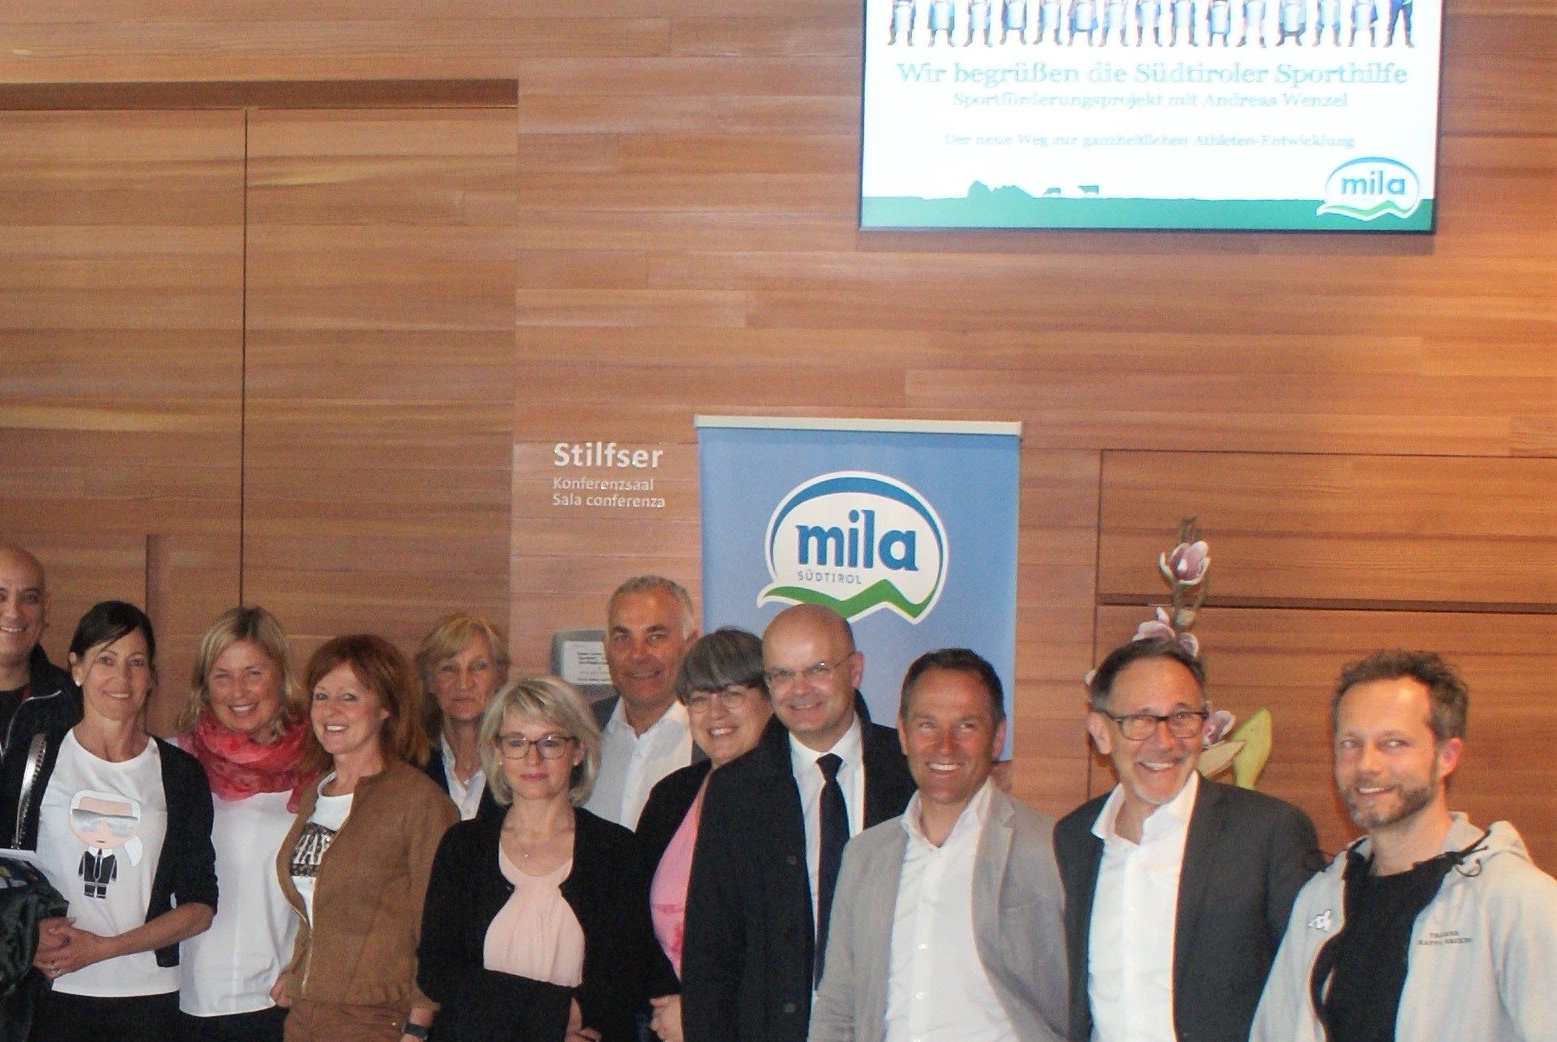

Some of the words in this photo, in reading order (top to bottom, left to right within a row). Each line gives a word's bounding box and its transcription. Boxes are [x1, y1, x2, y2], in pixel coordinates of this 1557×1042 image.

[897, 62, 947, 83] Wir
[954, 61, 1079, 88] begrüßen
[1087, 62, 1128, 83] die
[1134, 62, 1269, 84] Südtiroler
[1275, 62, 1408, 88] Sporthilfe
[953, 91, 1162, 109] Sportförderungsprojekt
[1168, 91, 1198, 107] mit
[1204, 92, 1277, 107] Andreas
[1282, 92, 1348, 107] Wenzel
[946, 133, 971, 145] Der
[976, 136, 1012, 145] neue
[1017, 134, 1048, 148] Weg
[1052, 136, 1077, 145] zur
[1341, 170, 1406, 195] mila
[554, 441, 664, 468] Stilfser
[553, 477, 654, 491] Konferenzsaal
[552, 493, 582, 506] Sala
[586, 494, 666, 508] conferenza
[795, 509, 919, 572] mila
[797, 570, 862, 585] SÜDTIROL
